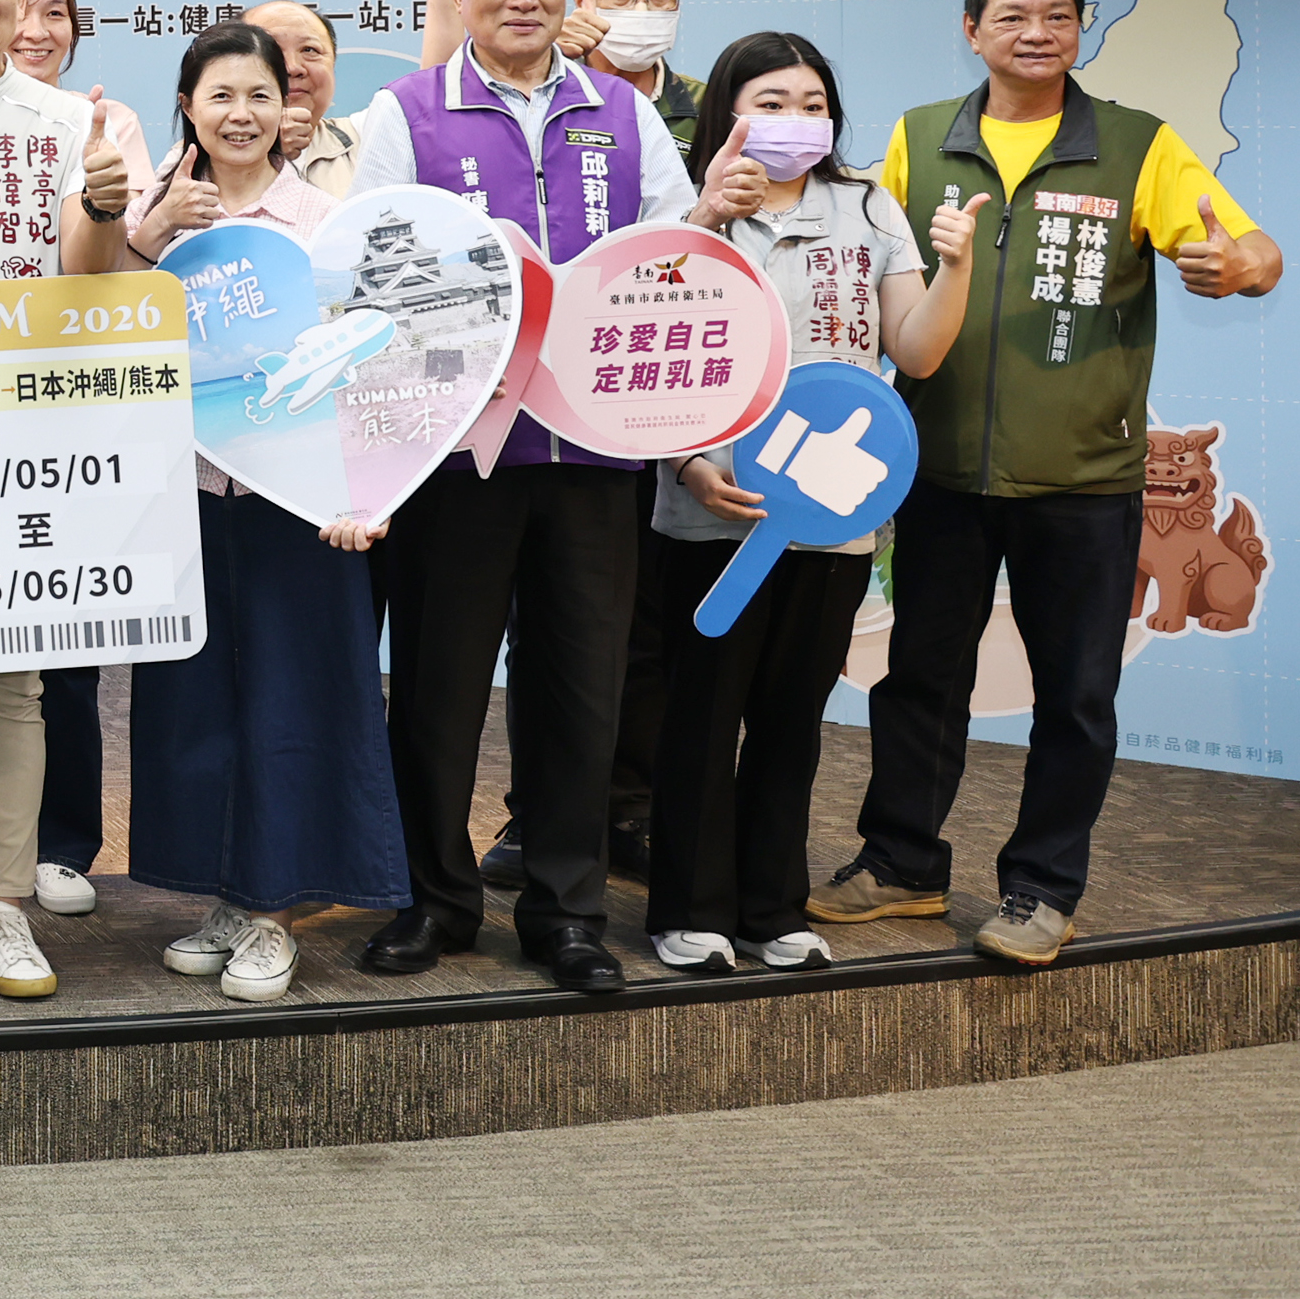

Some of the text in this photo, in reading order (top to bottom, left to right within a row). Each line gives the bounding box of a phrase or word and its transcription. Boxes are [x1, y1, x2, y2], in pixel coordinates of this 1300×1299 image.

[579, 132, 613, 145] DPP
[26, 134, 60, 245] 陳亭妃
[460, 156, 480, 187] 秘書
[580, 150, 610, 236] 邱莉莉
[1035, 191, 1118, 219] 臺南最好
[182, 257, 254, 293] KINAWA
[1030, 214, 1072, 304] 楊中成
[1070, 218, 1109, 306] 林俊憲
[59, 293, 163, 336] 2026
[609, 287, 724, 306] 臺南市政府衛生局
[805, 246, 845, 349] 周麗津
[840, 244, 872, 351] 陳亭妃
[589, 319, 730, 356] 珍愛自己
[1050, 309, 1072, 363] 聯合團隊
[15, 363, 180, 403] 日本沖繩/熊本
[345, 381, 454, 408] KUMAMOTO
[591, 356, 734, 394] 定期乳篩
[354, 402, 449, 452] 熊本
[17, 512, 54, 549] 至
